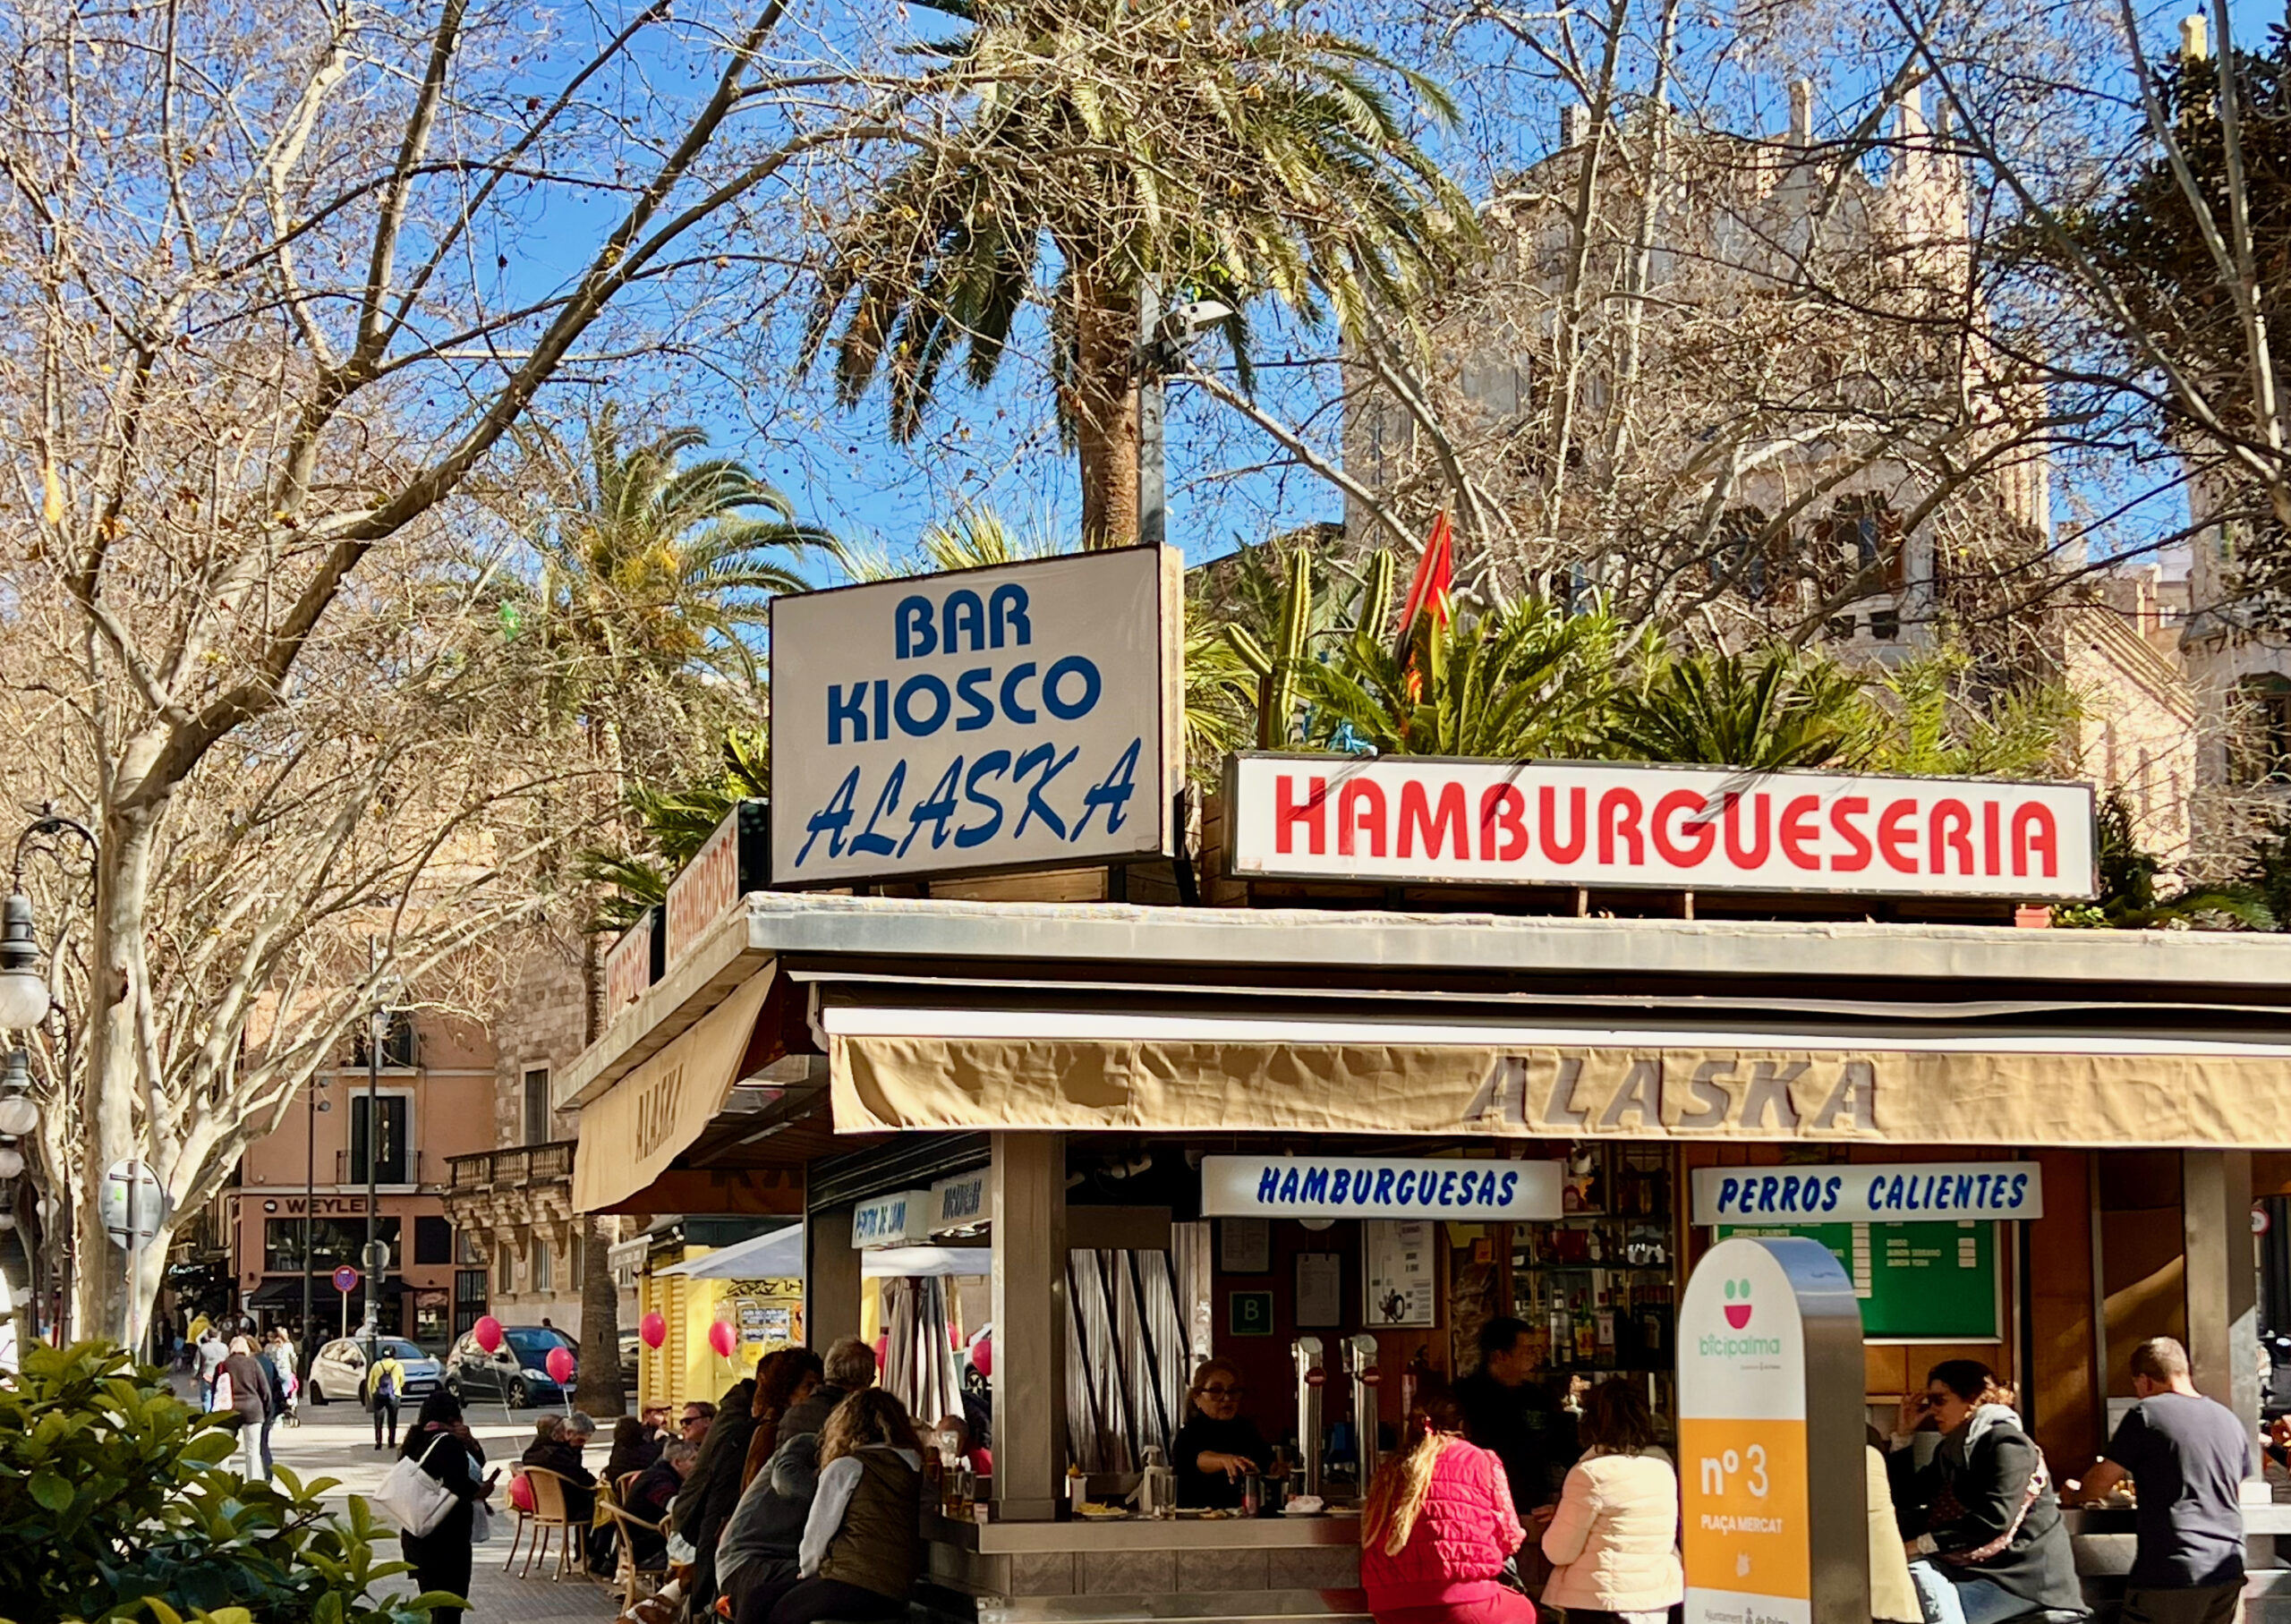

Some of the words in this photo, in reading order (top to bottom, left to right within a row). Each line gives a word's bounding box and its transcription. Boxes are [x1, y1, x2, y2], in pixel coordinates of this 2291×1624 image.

[895, 583, 1031, 659] BAR
[828, 655, 1102, 744] KIOSCO
[795, 737, 1141, 867] ALASKA
[1275, 775, 2058, 878] HAMBURGUESERIA
[1463, 1056, 1878, 1129] ALASKA
[1256, 1166, 1519, 1206] HAMBURGUESAS
[1717, 1175, 1842, 1213] PERROS
[1868, 1173, 2028, 1210] CALIENTES
[1244, 1299, 1260, 1321] B
[1746, 1443, 1769, 1497] 3
[1700, 1514, 1736, 1536] PLAÇA
[1737, 1516, 1783, 1534] MERCAT
